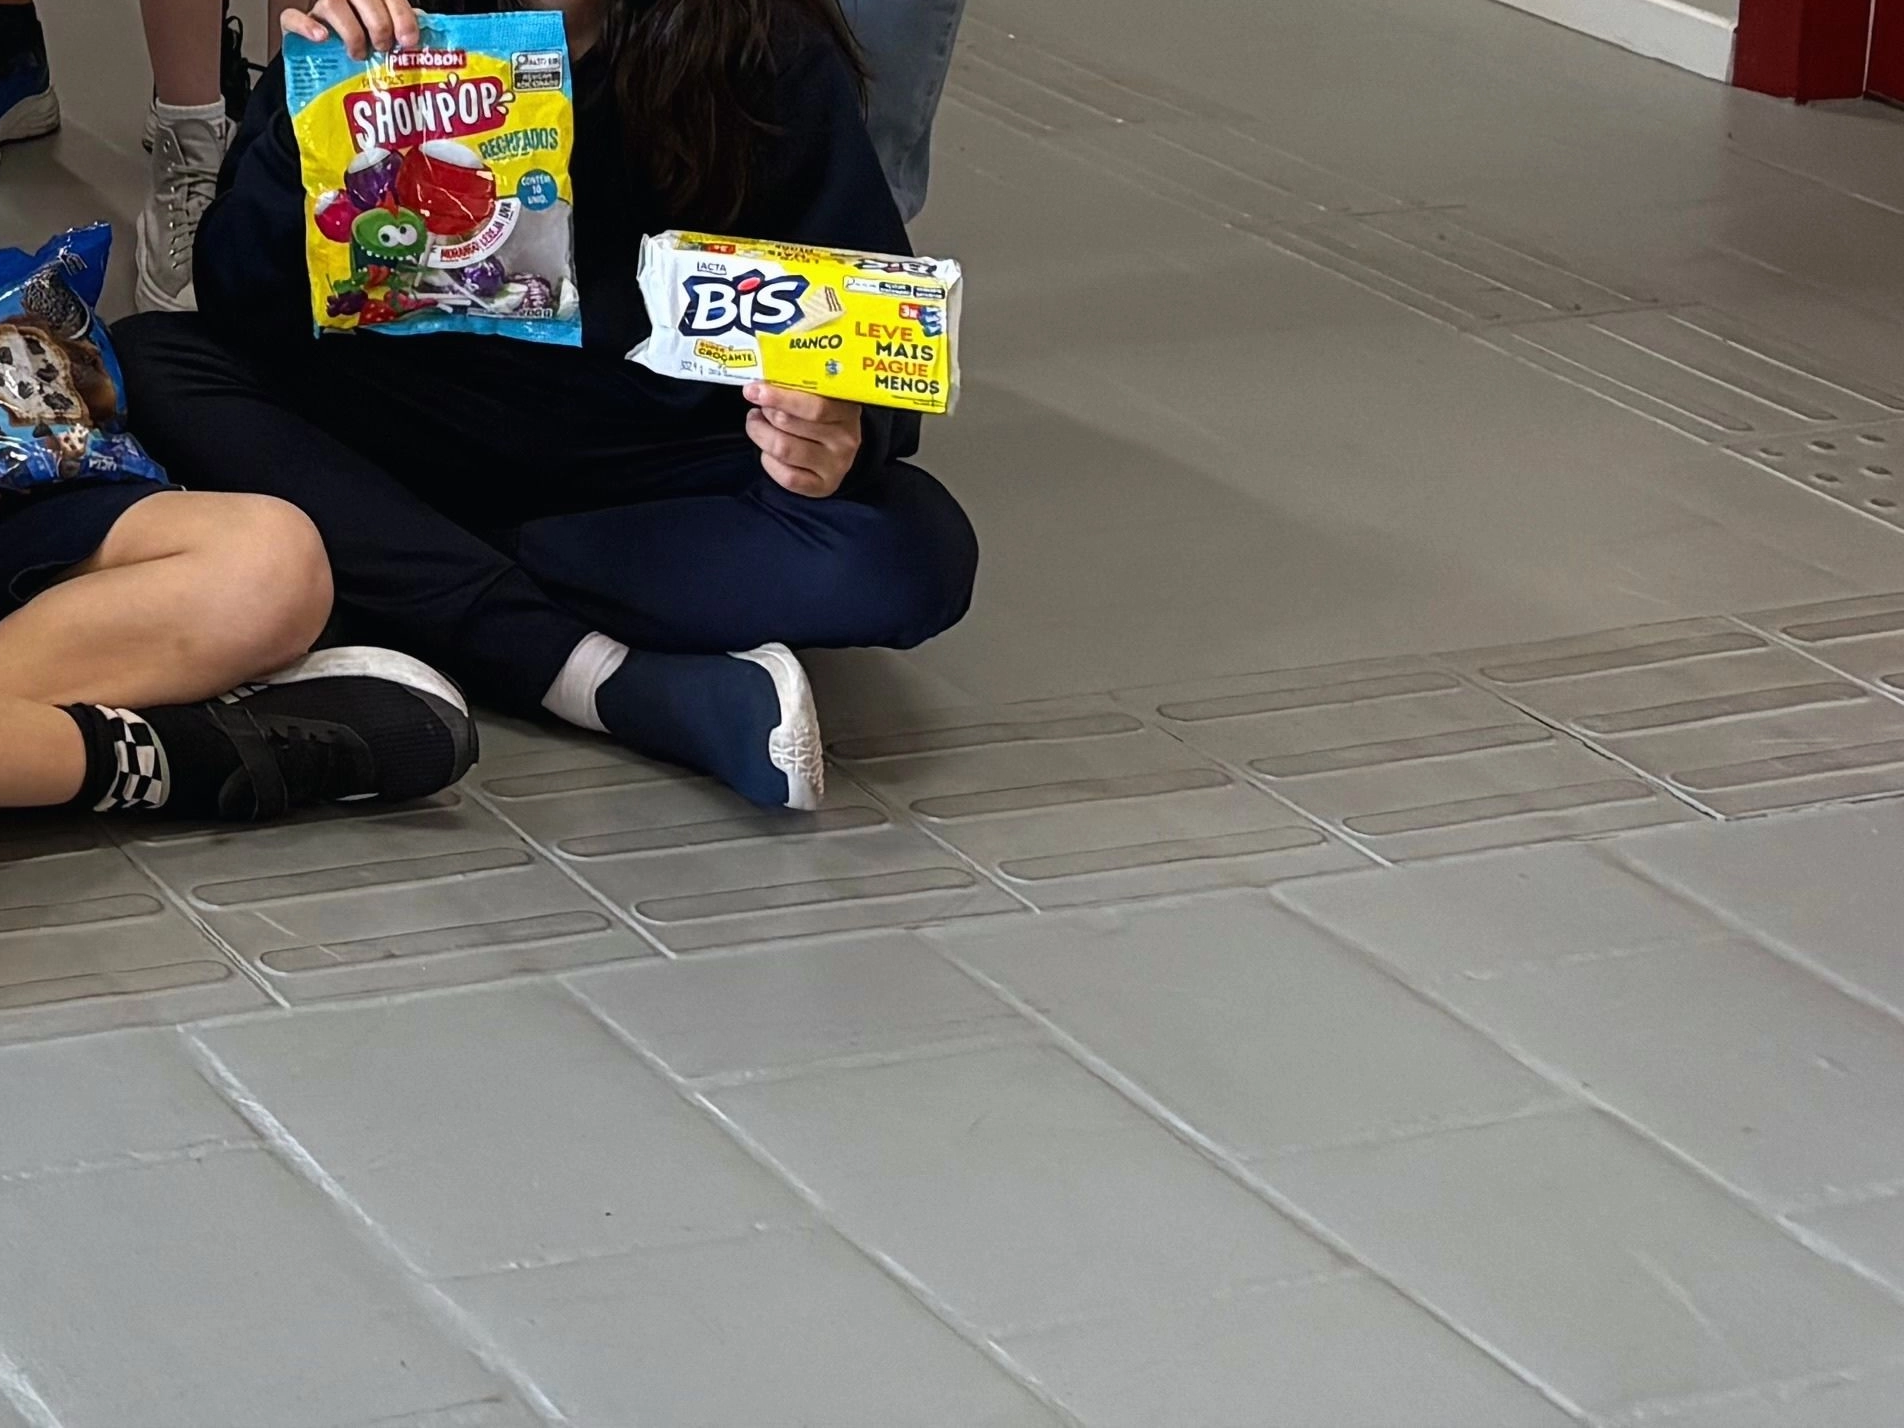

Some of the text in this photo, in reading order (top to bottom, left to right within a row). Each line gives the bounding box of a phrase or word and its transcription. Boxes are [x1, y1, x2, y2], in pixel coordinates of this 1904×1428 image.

[391, 52, 464, 67] PIETROBON
[697, 261, 727, 274] LACTA
[789, 334, 843, 349] BRANCO
[855, 321, 913, 342] LEVE
[876, 340, 934, 362] MAIS
[862, 357, 928, 378] PAGUE
[875, 374, 940, 395] MENOS
